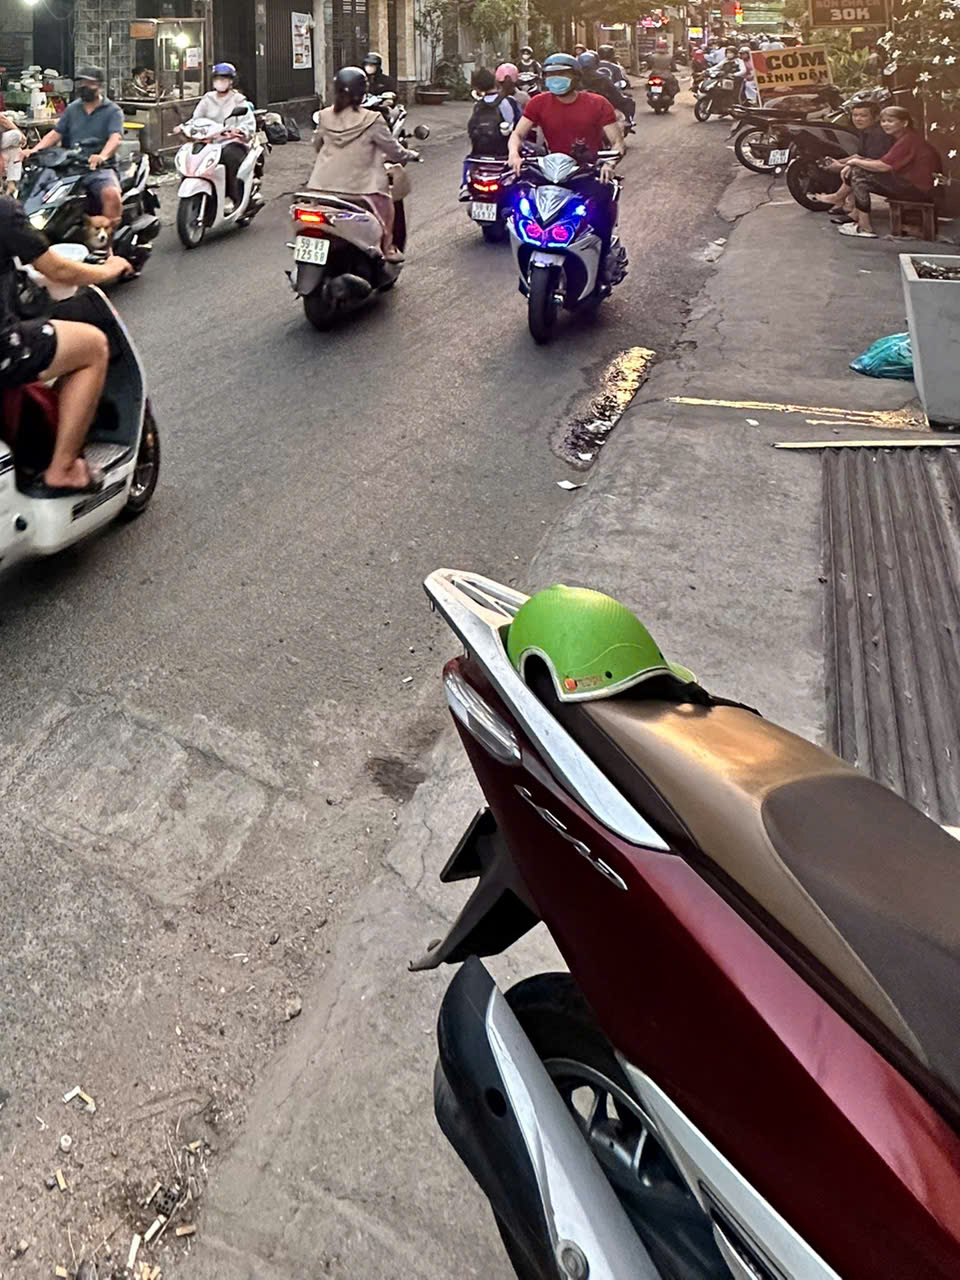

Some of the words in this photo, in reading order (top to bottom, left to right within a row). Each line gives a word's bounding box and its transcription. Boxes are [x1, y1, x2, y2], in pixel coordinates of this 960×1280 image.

[830, 7, 870, 20] 30K
[766, 52, 827, 71] CƠM
[757, 70, 794, 84] BÌNH
